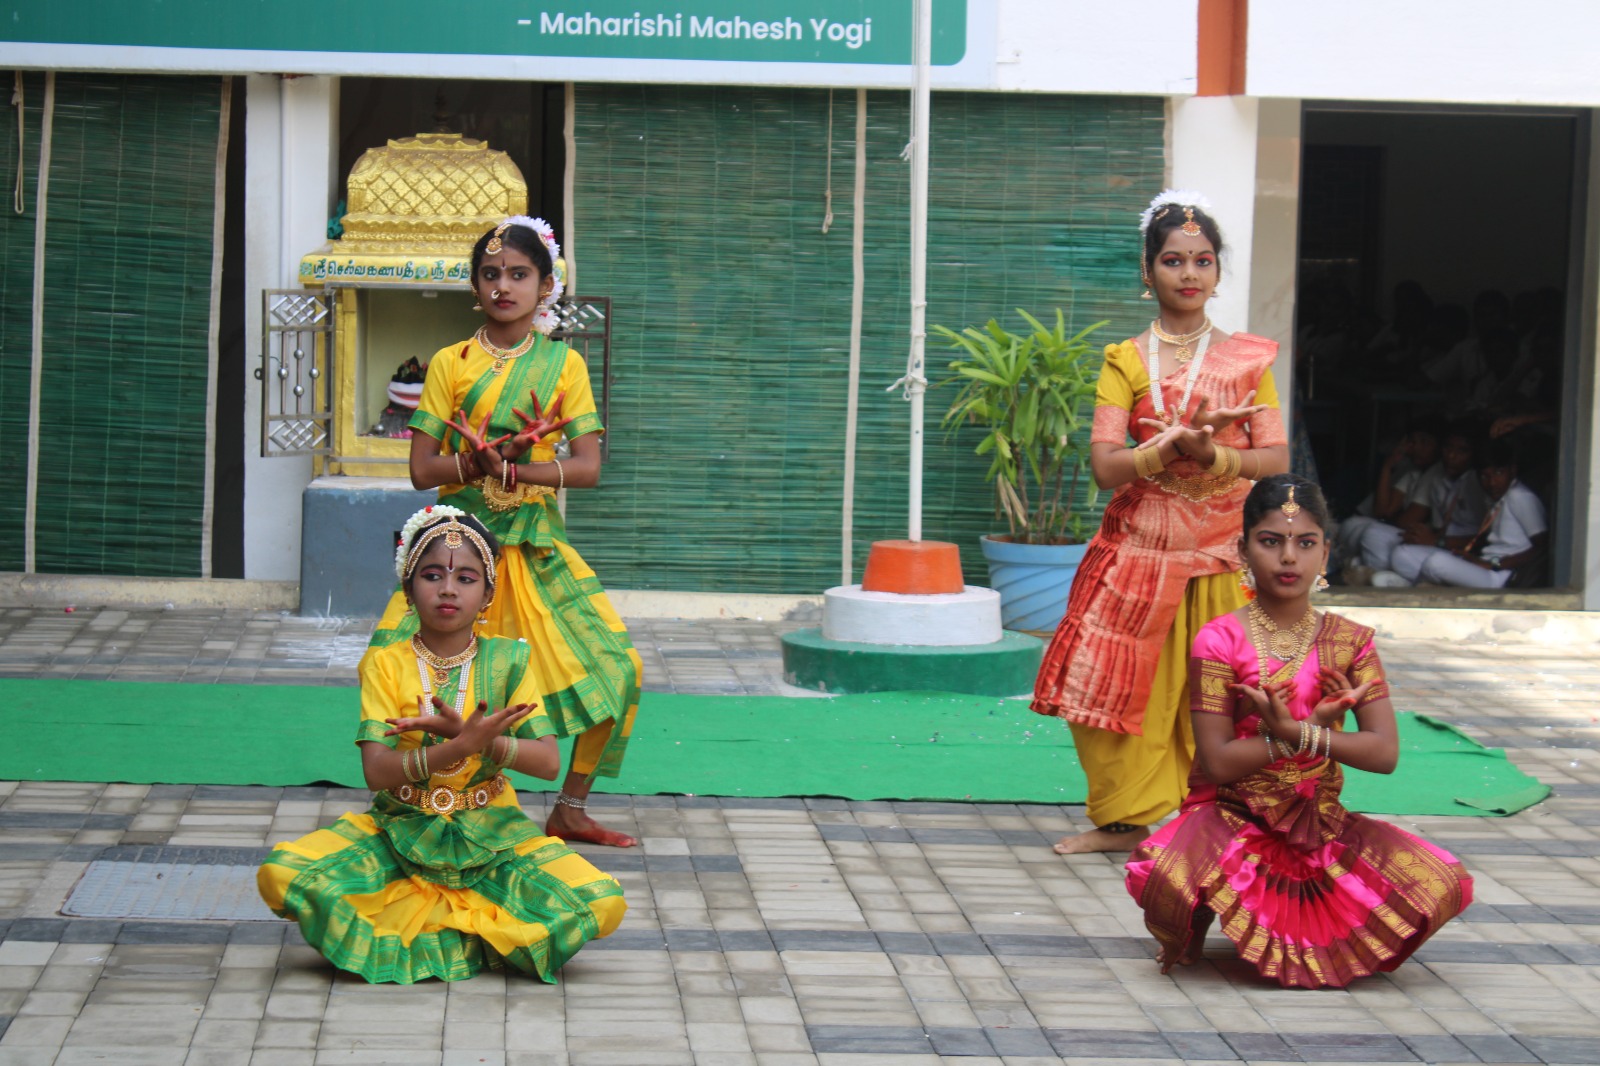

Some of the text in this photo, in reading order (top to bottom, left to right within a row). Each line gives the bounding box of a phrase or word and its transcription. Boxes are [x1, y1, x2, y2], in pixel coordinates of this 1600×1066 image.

[540, 12, 682, 37] Maharishi
[690, 15, 803, 40] Mahesh
[809, 17, 873, 49] Yogi
